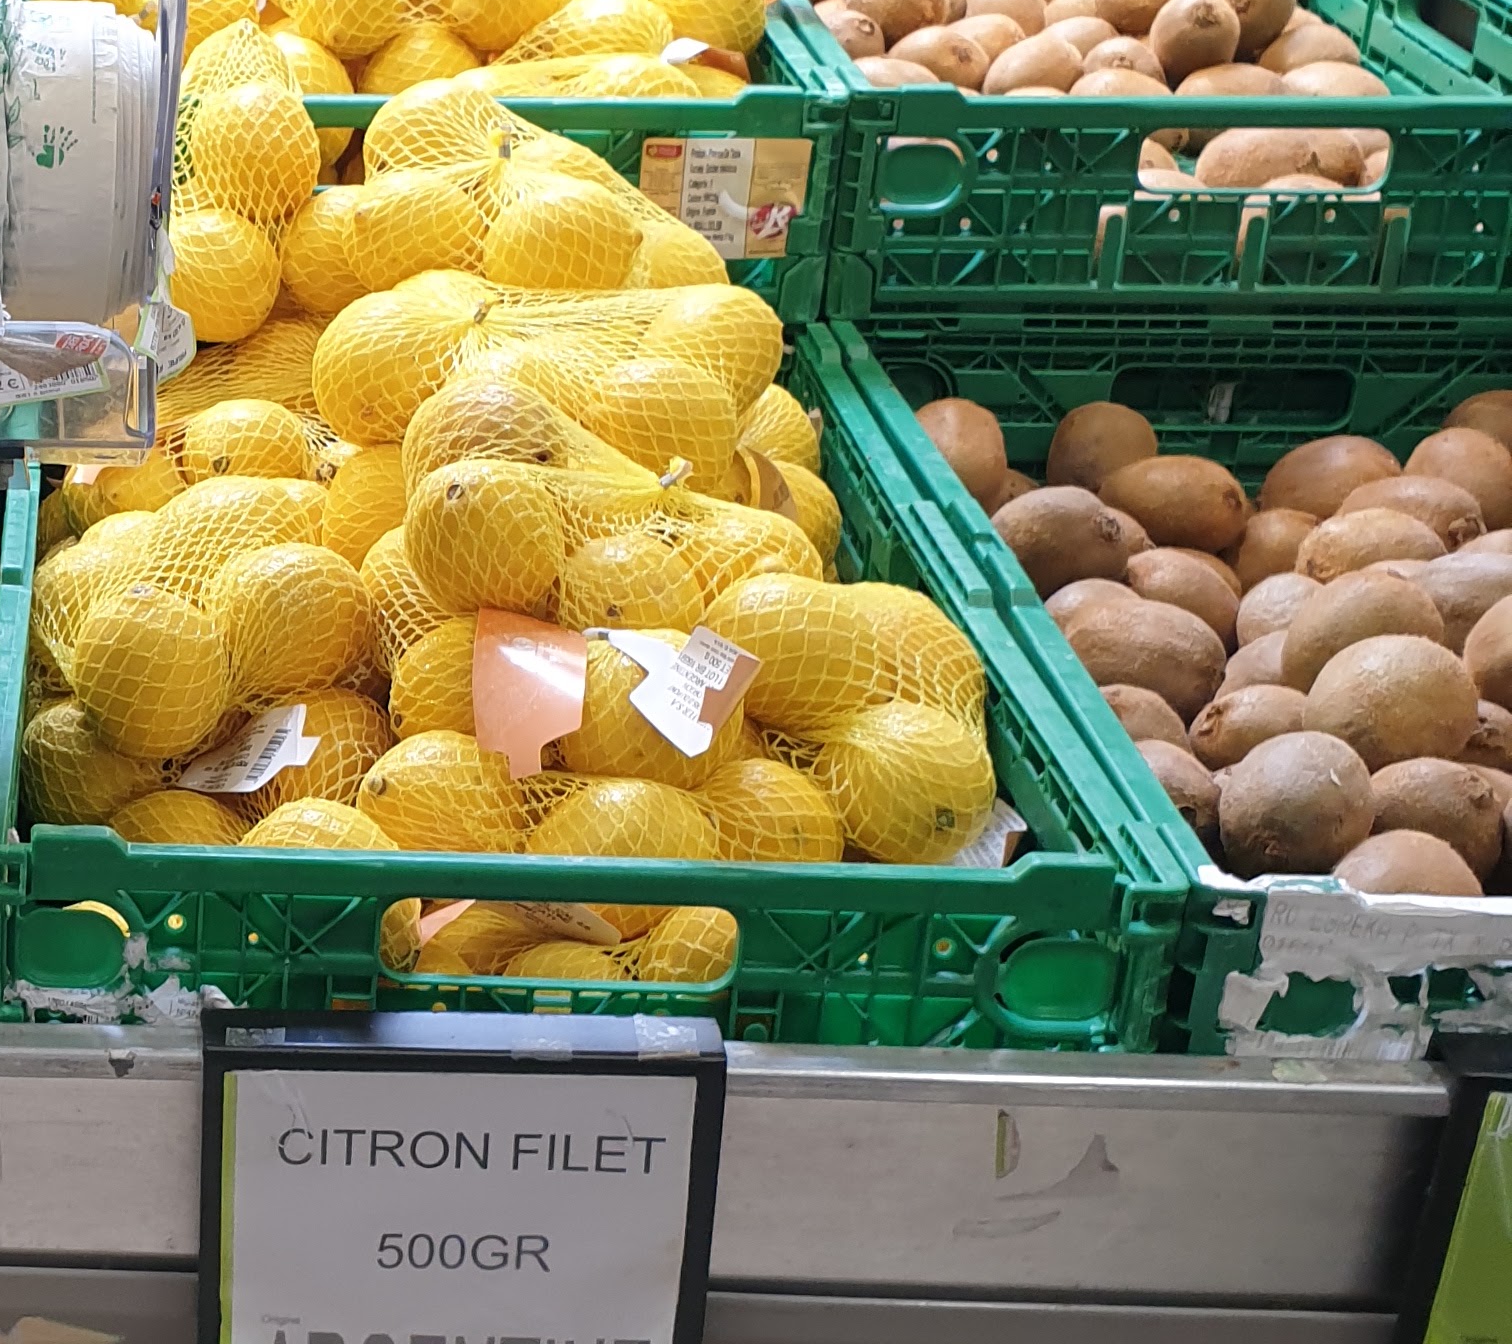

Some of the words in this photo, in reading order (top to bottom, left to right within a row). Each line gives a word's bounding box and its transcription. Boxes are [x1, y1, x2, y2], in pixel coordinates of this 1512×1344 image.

[277, 1128, 490, 1170] CITRON
[511, 1133, 667, 1175] FILET
[376, 1233, 551, 1273] 500GR
